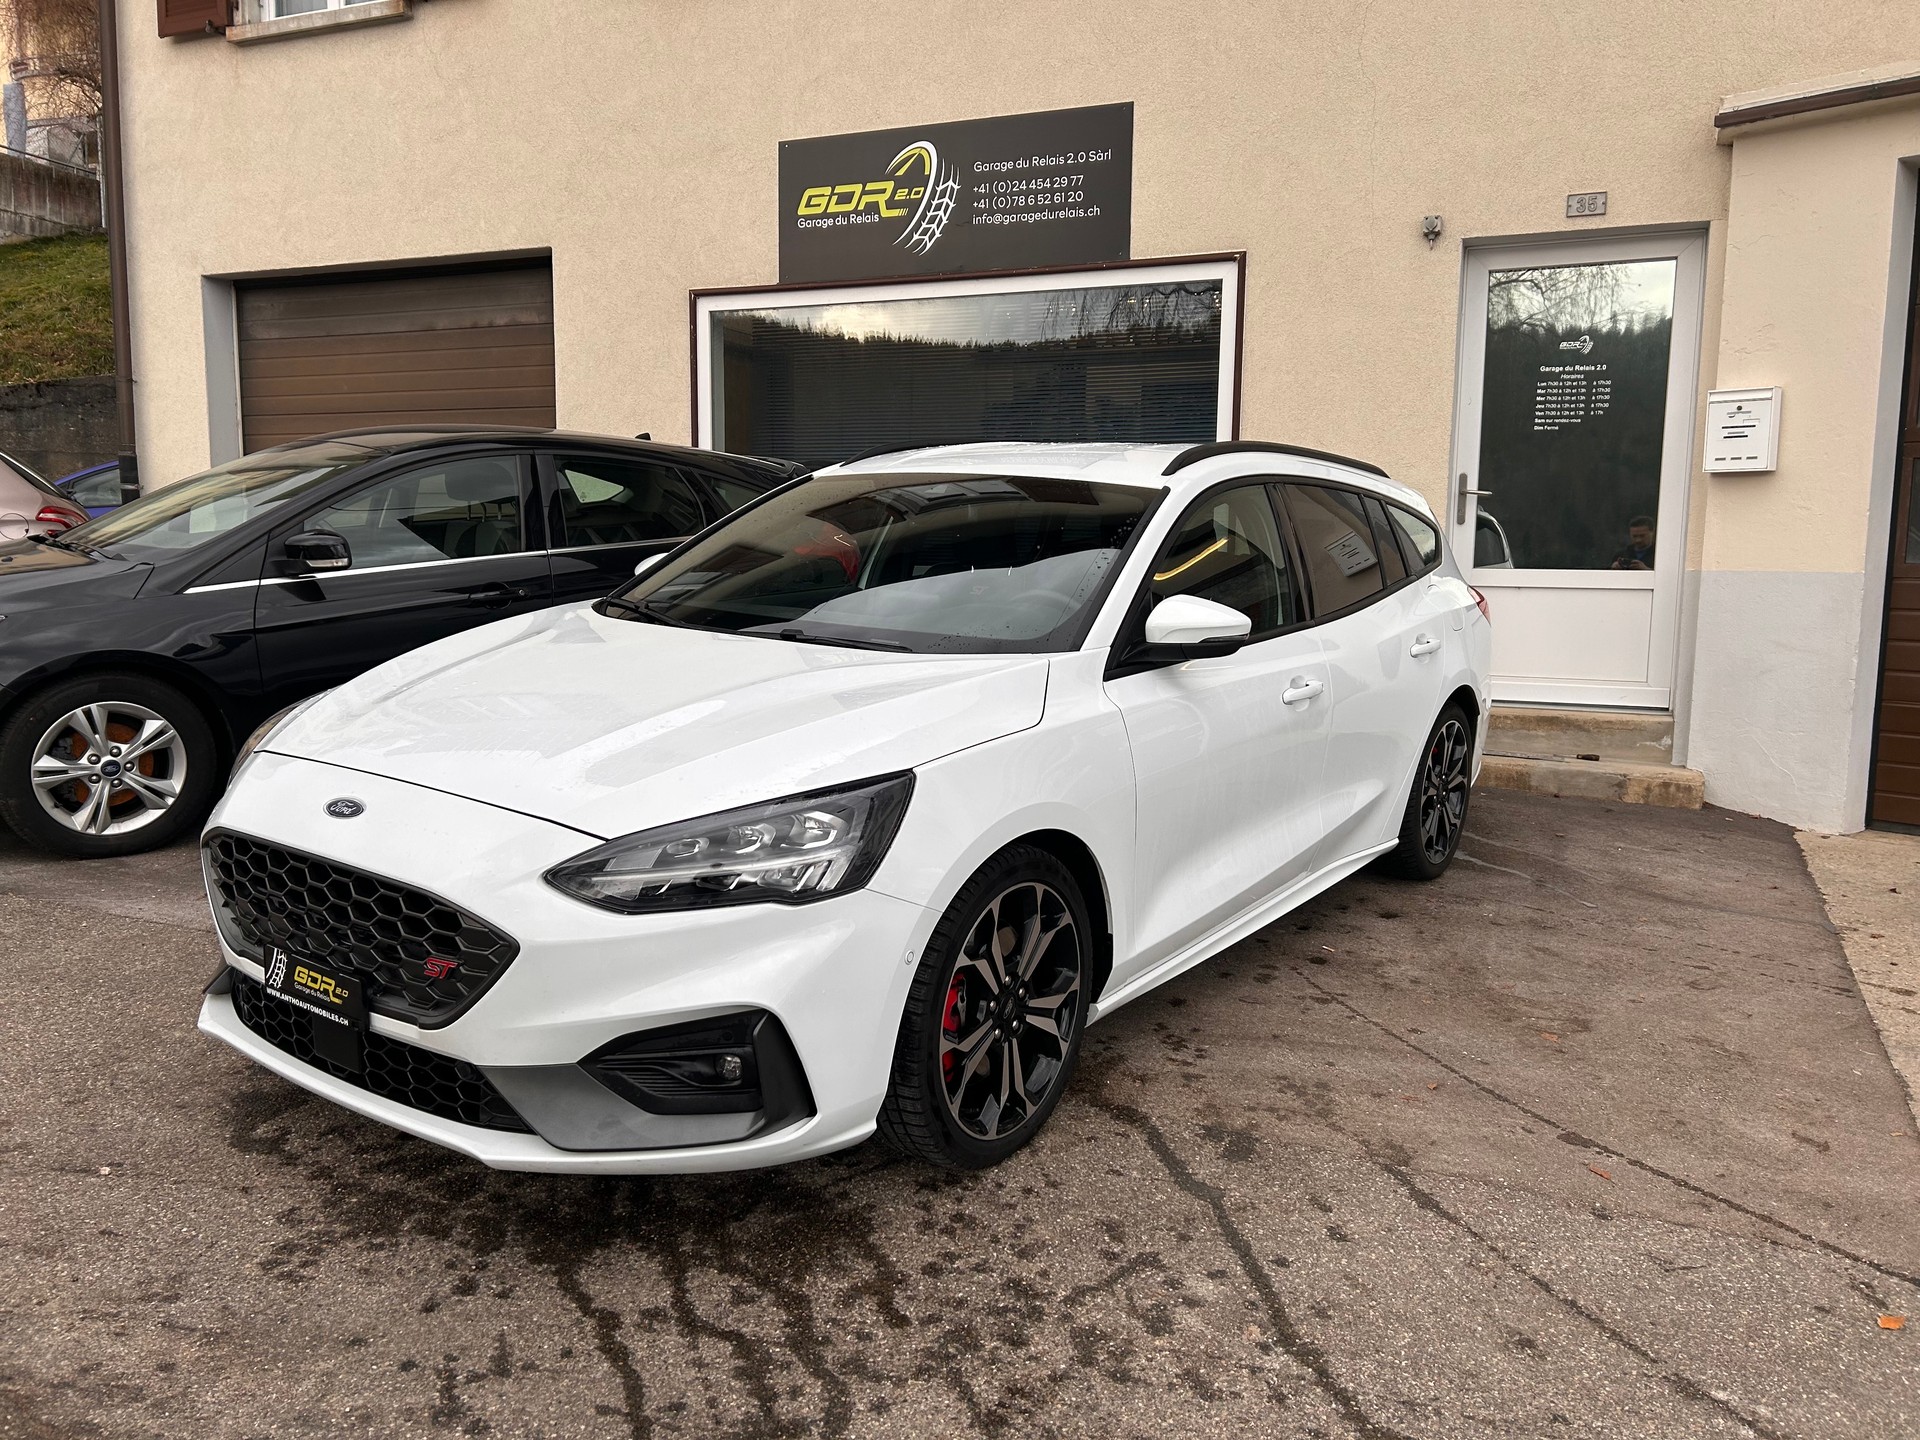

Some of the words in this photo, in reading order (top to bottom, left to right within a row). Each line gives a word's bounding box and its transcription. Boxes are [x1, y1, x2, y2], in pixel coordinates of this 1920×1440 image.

[973, 161, 1014, 172] Garage
[1015, 157, 1029, 169] du
[1032, 154, 1065, 167] Relais
[1066, 152, 1086, 164] 2.0
[1089, 149, 1112, 162] Sàrl
[973, 183, 989, 194] +41
[1028, 178, 1051, 189] 454
[1053, 176, 1068, 188] 29
[1070, 175, 1084, 186] 77
[797, 180, 901, 217] GDR
[894, 186, 925, 201] 2.0
[973, 198, 989, 209] +41
[1037, 193, 1052, 205] 52
[1054, 192, 1065, 203] 61
[1067, 190, 1084, 202] 20
[1576, 196, 1598, 213] 35
[797, 217, 834, 229] Garage
[835, 215, 847, 225] du
[850, 212, 879, 224] Relais
[972, 205, 1100, 225] info@garagedurelais.ch
[423, 957, 458, 979] ST
[294, 965, 343, 1005] GDR
[335, 987, 349, 997] 2.0
[266, 987, 349, 1026] WWW.ANTHOAUTOMOBILES.CH
